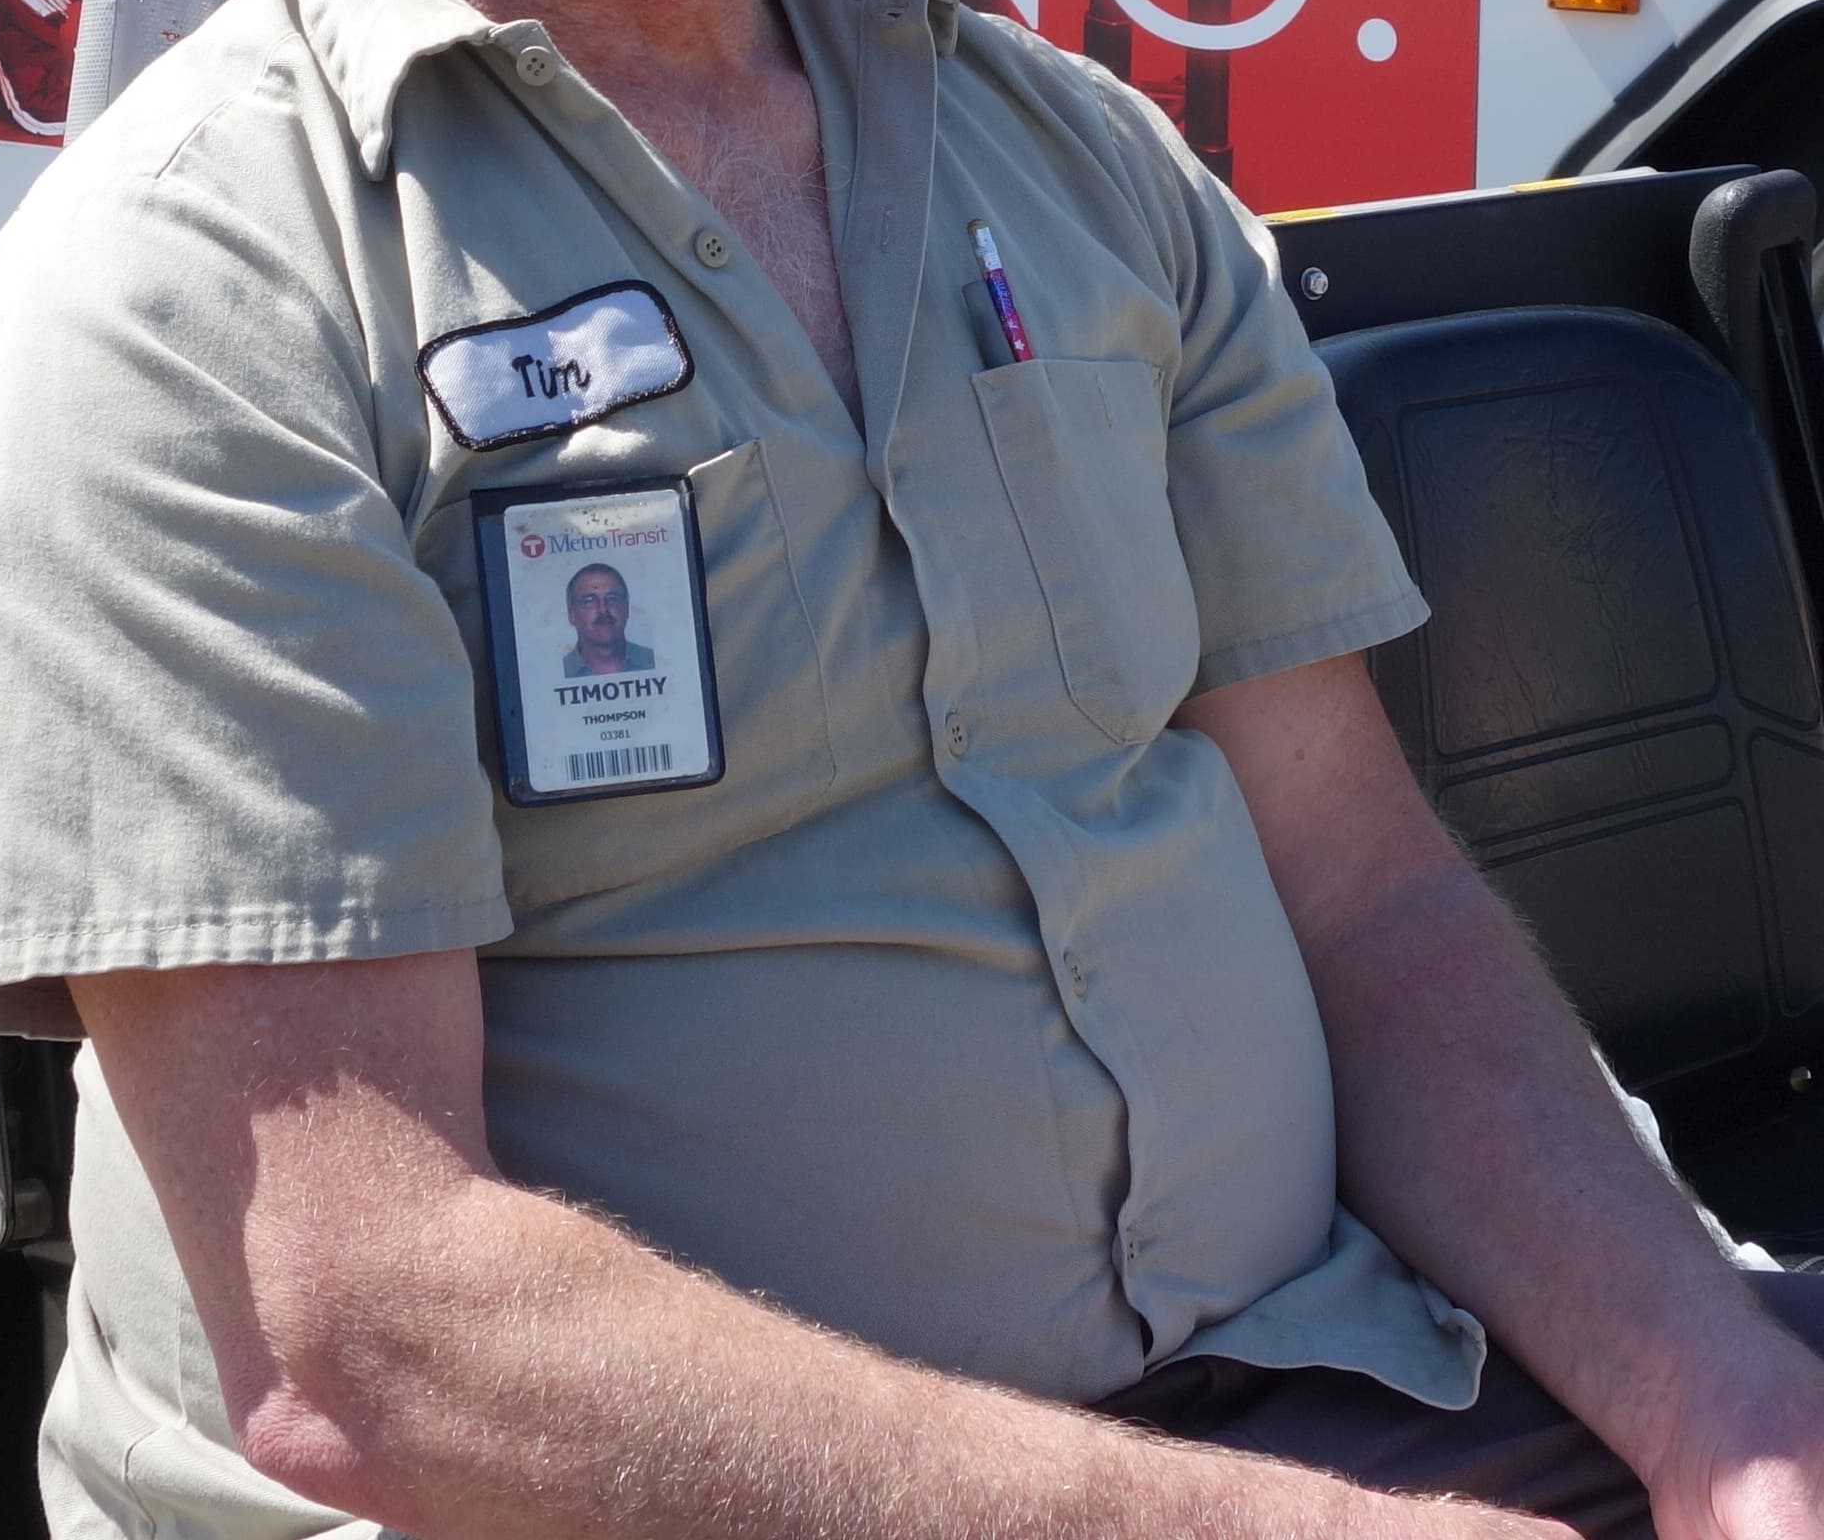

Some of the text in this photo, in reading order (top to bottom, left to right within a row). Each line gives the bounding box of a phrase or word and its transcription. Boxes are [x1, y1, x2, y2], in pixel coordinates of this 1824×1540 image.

[511, 353, 592, 399] Tim
[553, 675, 668, 706] TIMOTHY
[582, 709, 647, 725] THOMPSON
[599, 729, 631, 741] 03381
